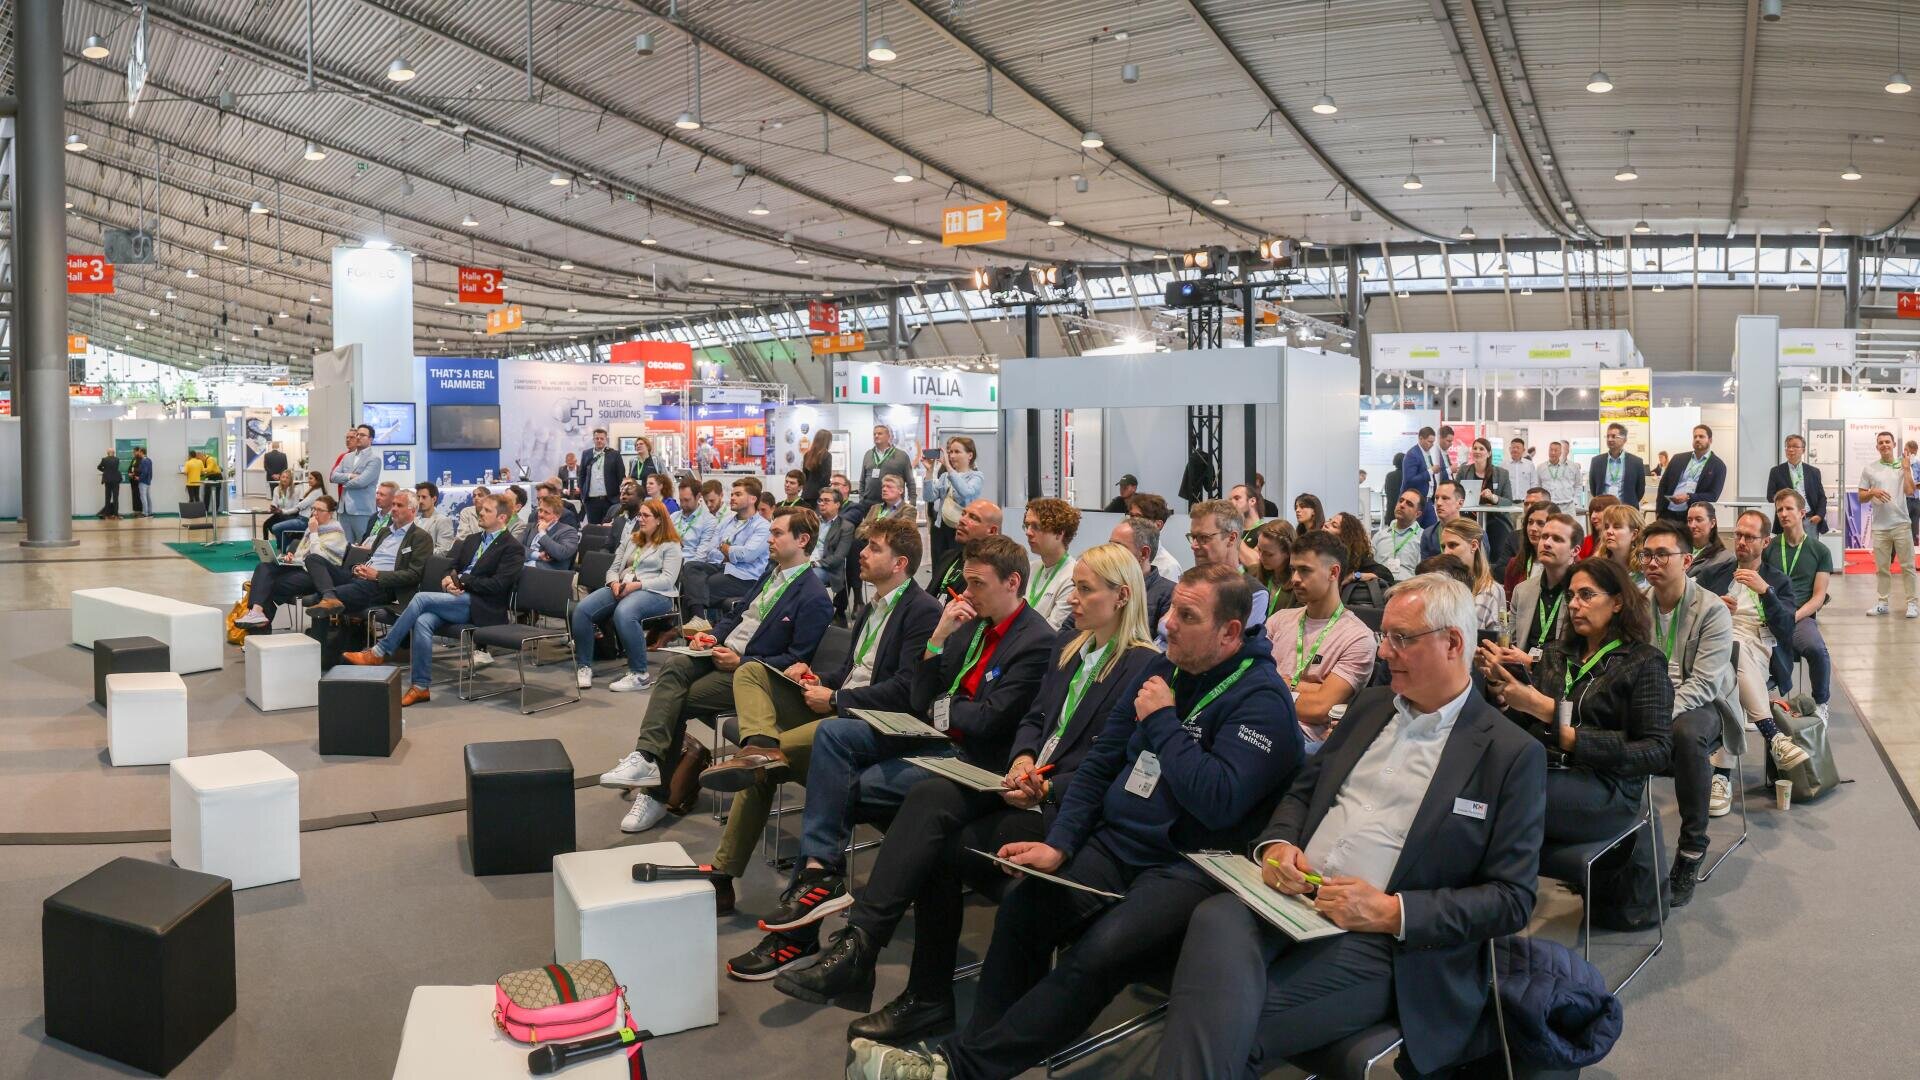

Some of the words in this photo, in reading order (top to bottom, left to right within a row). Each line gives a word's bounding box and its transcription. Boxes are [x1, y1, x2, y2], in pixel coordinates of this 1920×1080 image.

[90, 259, 104, 281] 3
[347, 266, 396, 279] FOEC
[461, 271, 481, 281] Halle
[461, 283, 477, 292] Hall
[482, 273, 495, 293] 3
[828, 307, 836, 323] 3
[430, 368, 463, 379] THAT'S
[464, 369, 471, 379] A
[472, 369, 495, 380] REAL
[591, 374, 641, 386] FORTEC
[440, 379, 486, 390] HAMMER!
[913, 375, 961, 397] ITALIA
[598, 399, 632, 408] MEDICAL
[598, 409, 641, 419] SOLUTIONS
[1209, 667, 1245, 698] edtecLIVE
[1239, 724, 1273, 748] Rocketing
